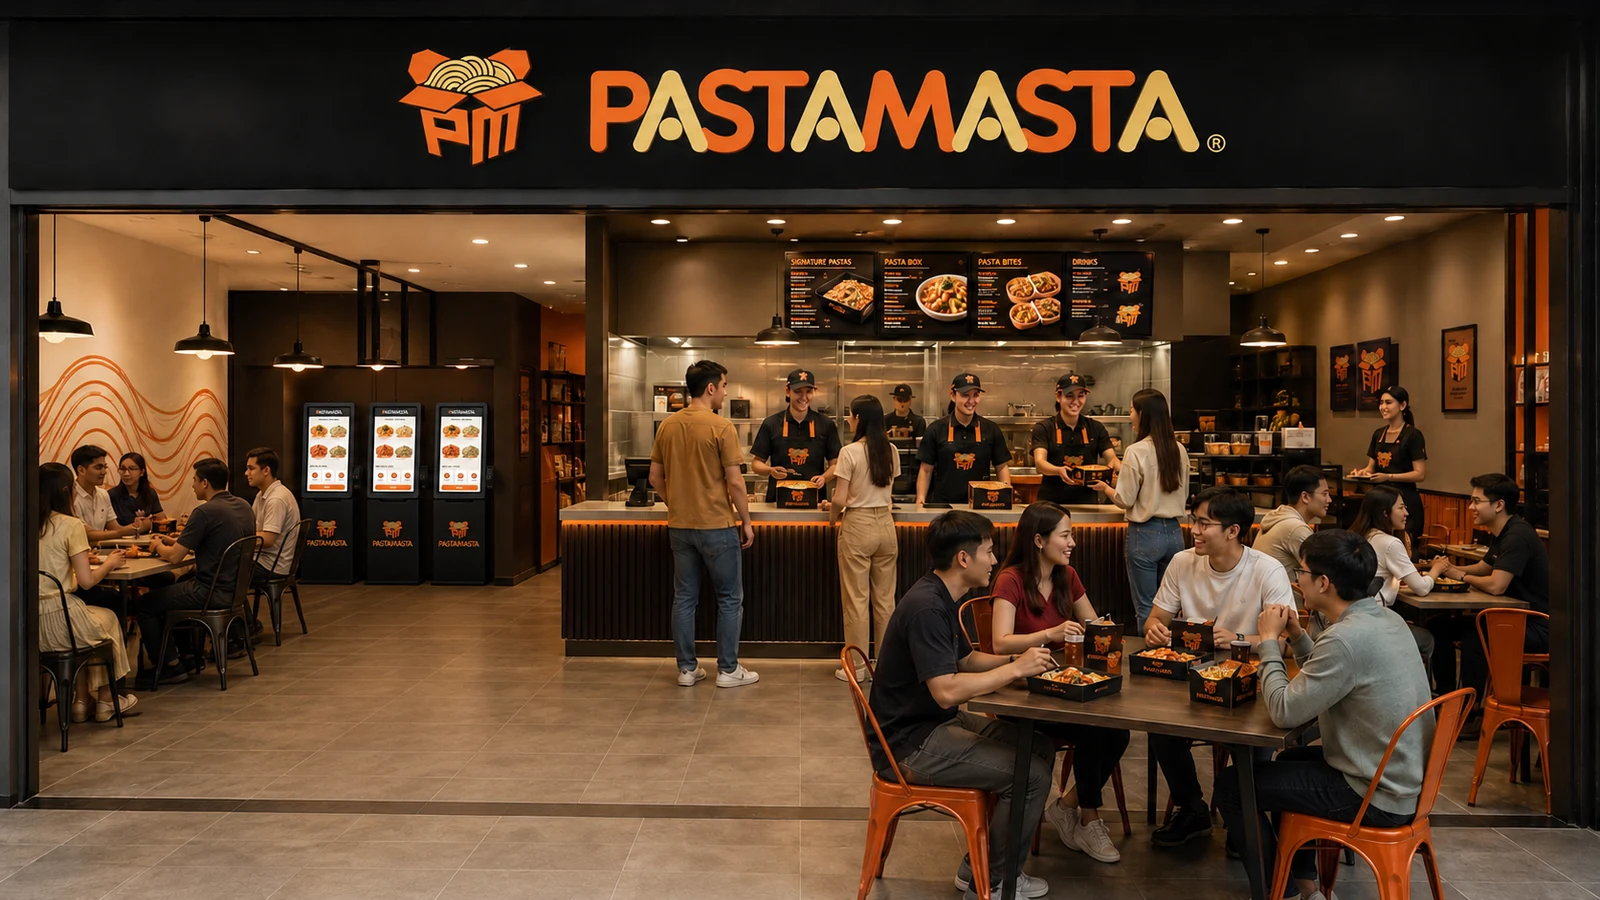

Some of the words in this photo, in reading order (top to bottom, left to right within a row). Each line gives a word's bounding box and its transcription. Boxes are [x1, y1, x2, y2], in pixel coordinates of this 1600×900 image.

[589, 68, 1200, 154] PASTAMASTA
[790, 258, 827, 266] SIGNATURE
[828, 258, 852, 266] PASTAS
[884, 258, 906, 266] PASTA
[907, 258, 923, 266] BOX
[978, 258, 1001, 266] PASTA
[1002, 258, 1022, 266] BITES
[1072, 258, 1098, 266] DRINKS
